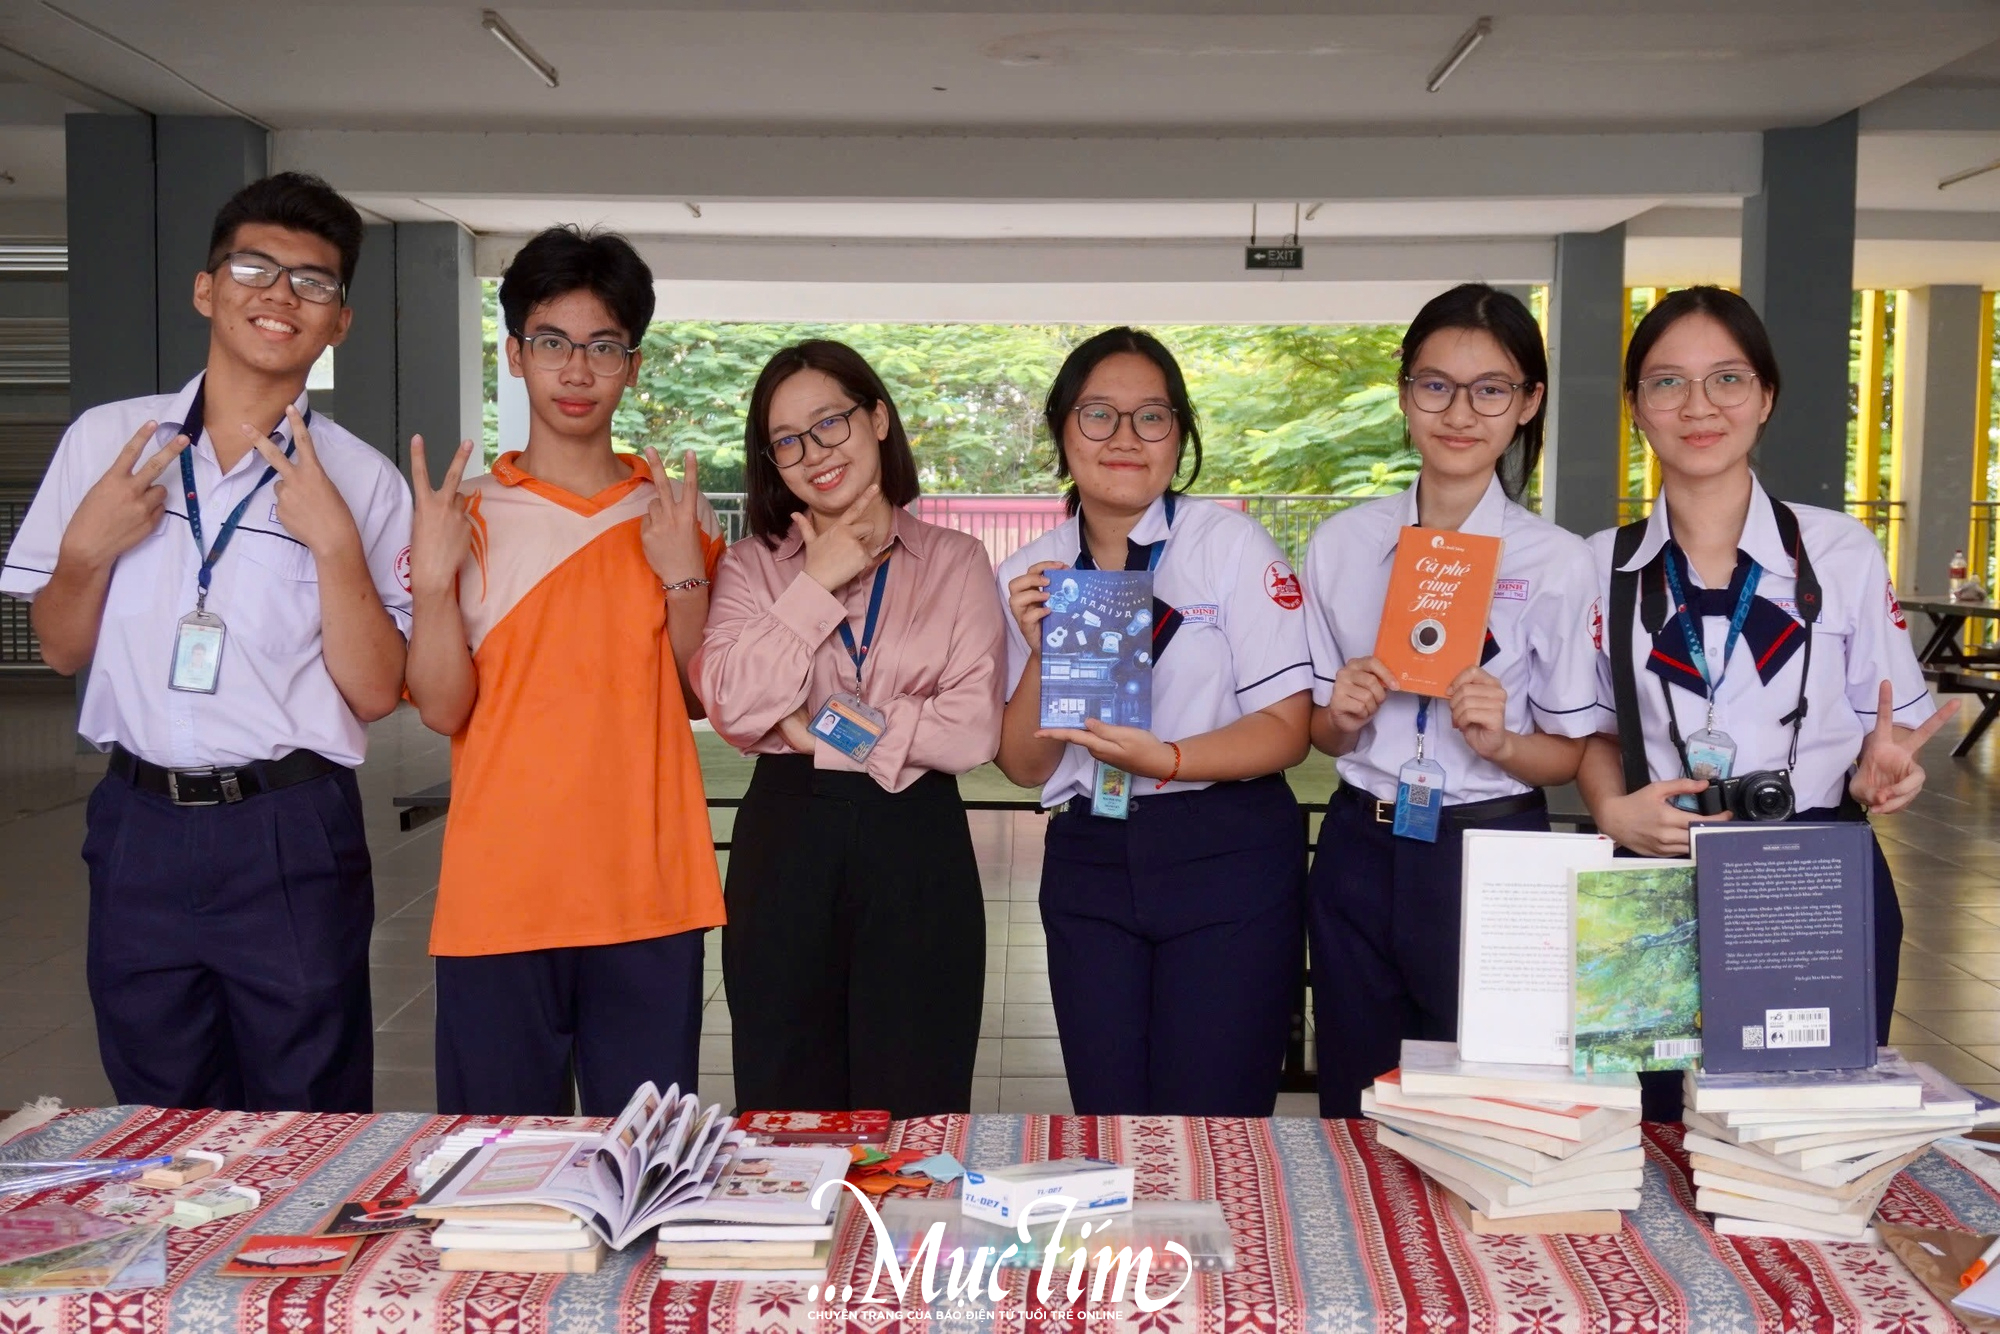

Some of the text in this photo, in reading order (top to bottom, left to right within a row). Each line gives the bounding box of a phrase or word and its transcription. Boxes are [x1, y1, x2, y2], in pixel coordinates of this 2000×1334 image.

[1268, 250, 1296, 260] EXIT
[1415, 556, 1471, 578] Cà phê
[1419, 577, 1461, 597] cùng
[1080, 596, 1132, 618] NAMIYA
[965, 1193, 1000, 1208] TL-027
